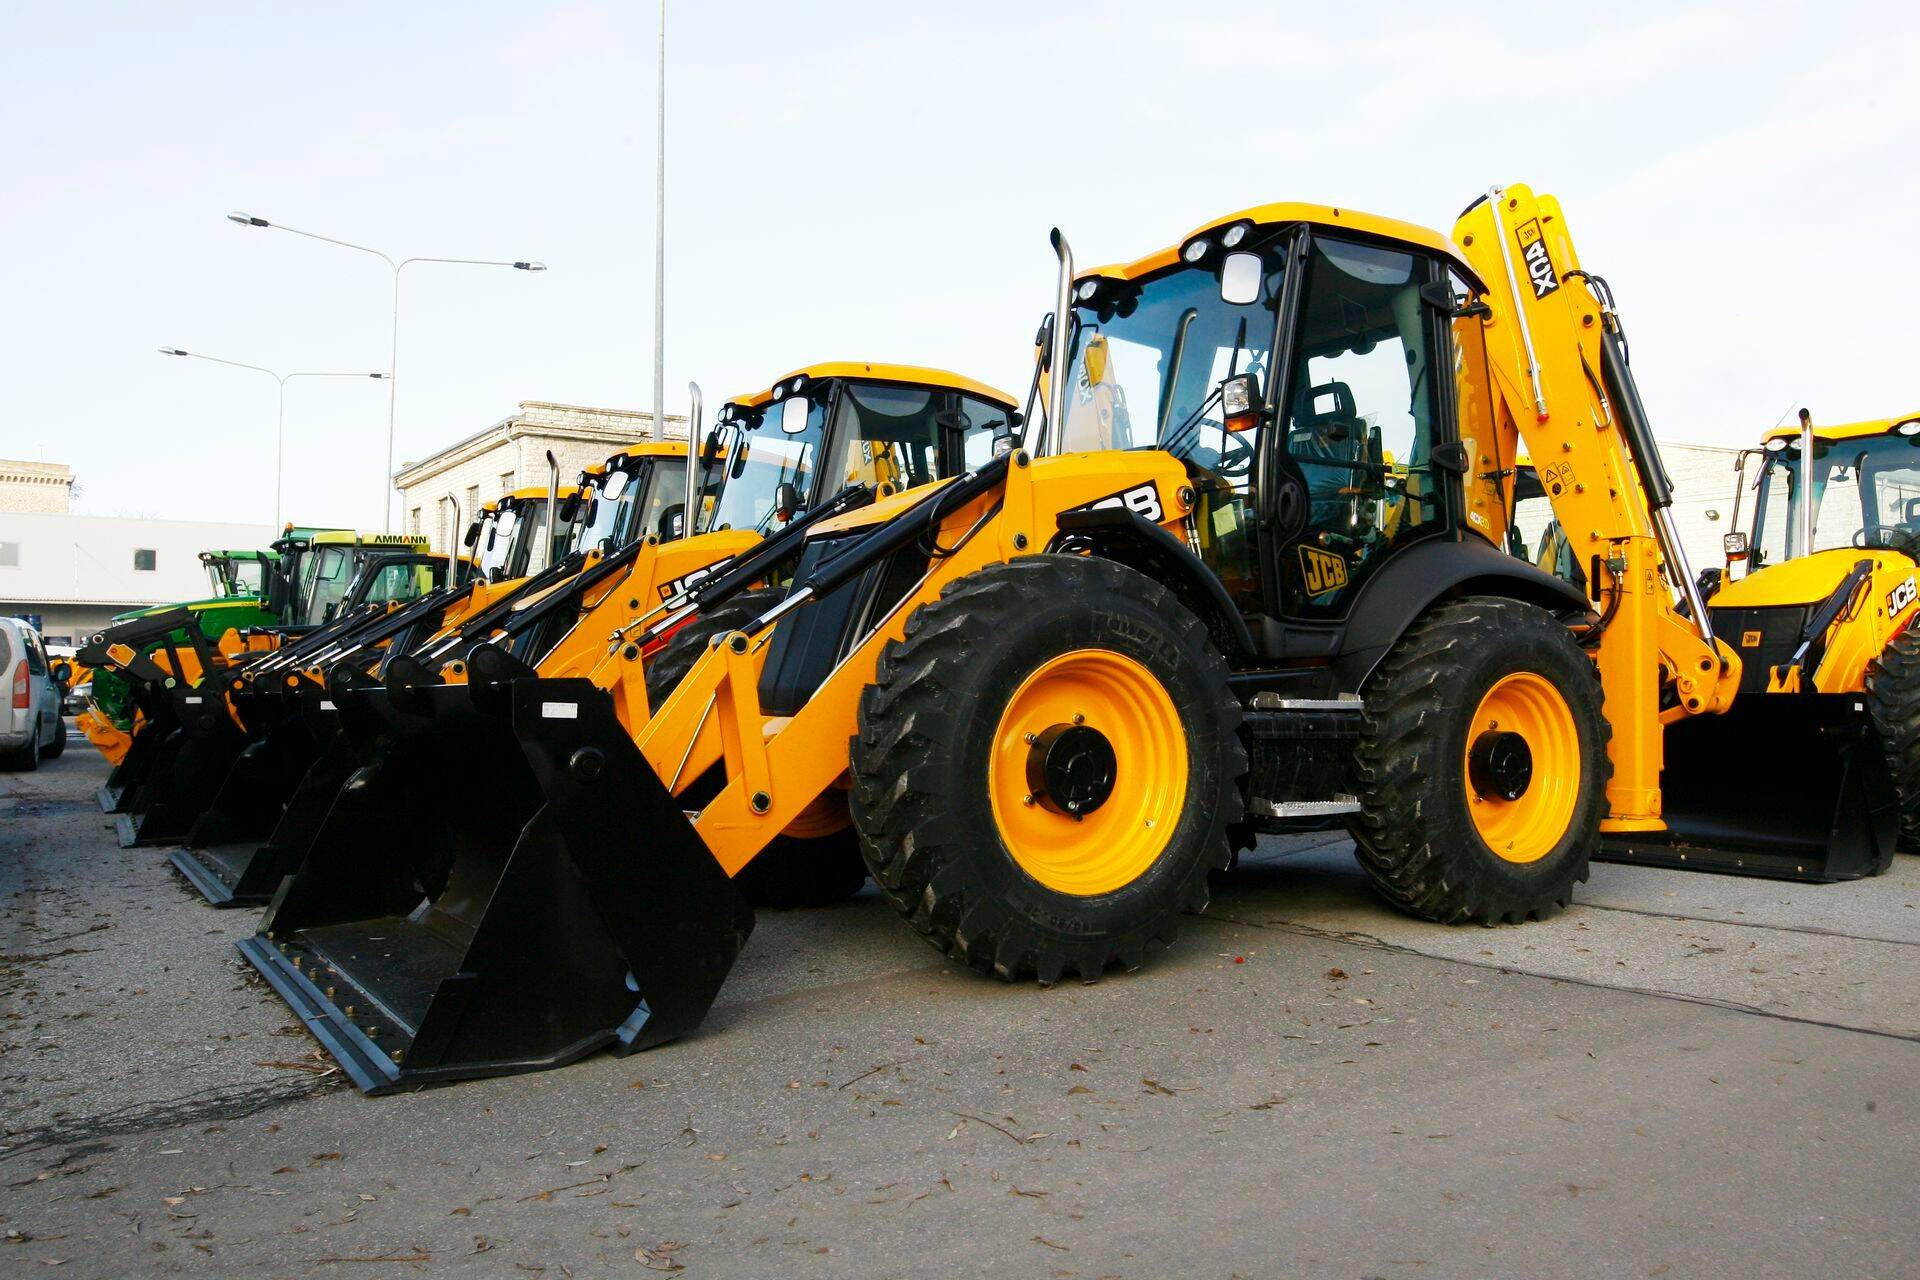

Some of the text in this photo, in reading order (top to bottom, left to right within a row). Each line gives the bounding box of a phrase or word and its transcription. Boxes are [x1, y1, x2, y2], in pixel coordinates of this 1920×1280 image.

[1525, 241, 1558, 296] 4CX
[374, 535, 427, 544] AMMANN
[1307, 550, 1345, 591] JCB
[1888, 576, 1917, 617] JCB
